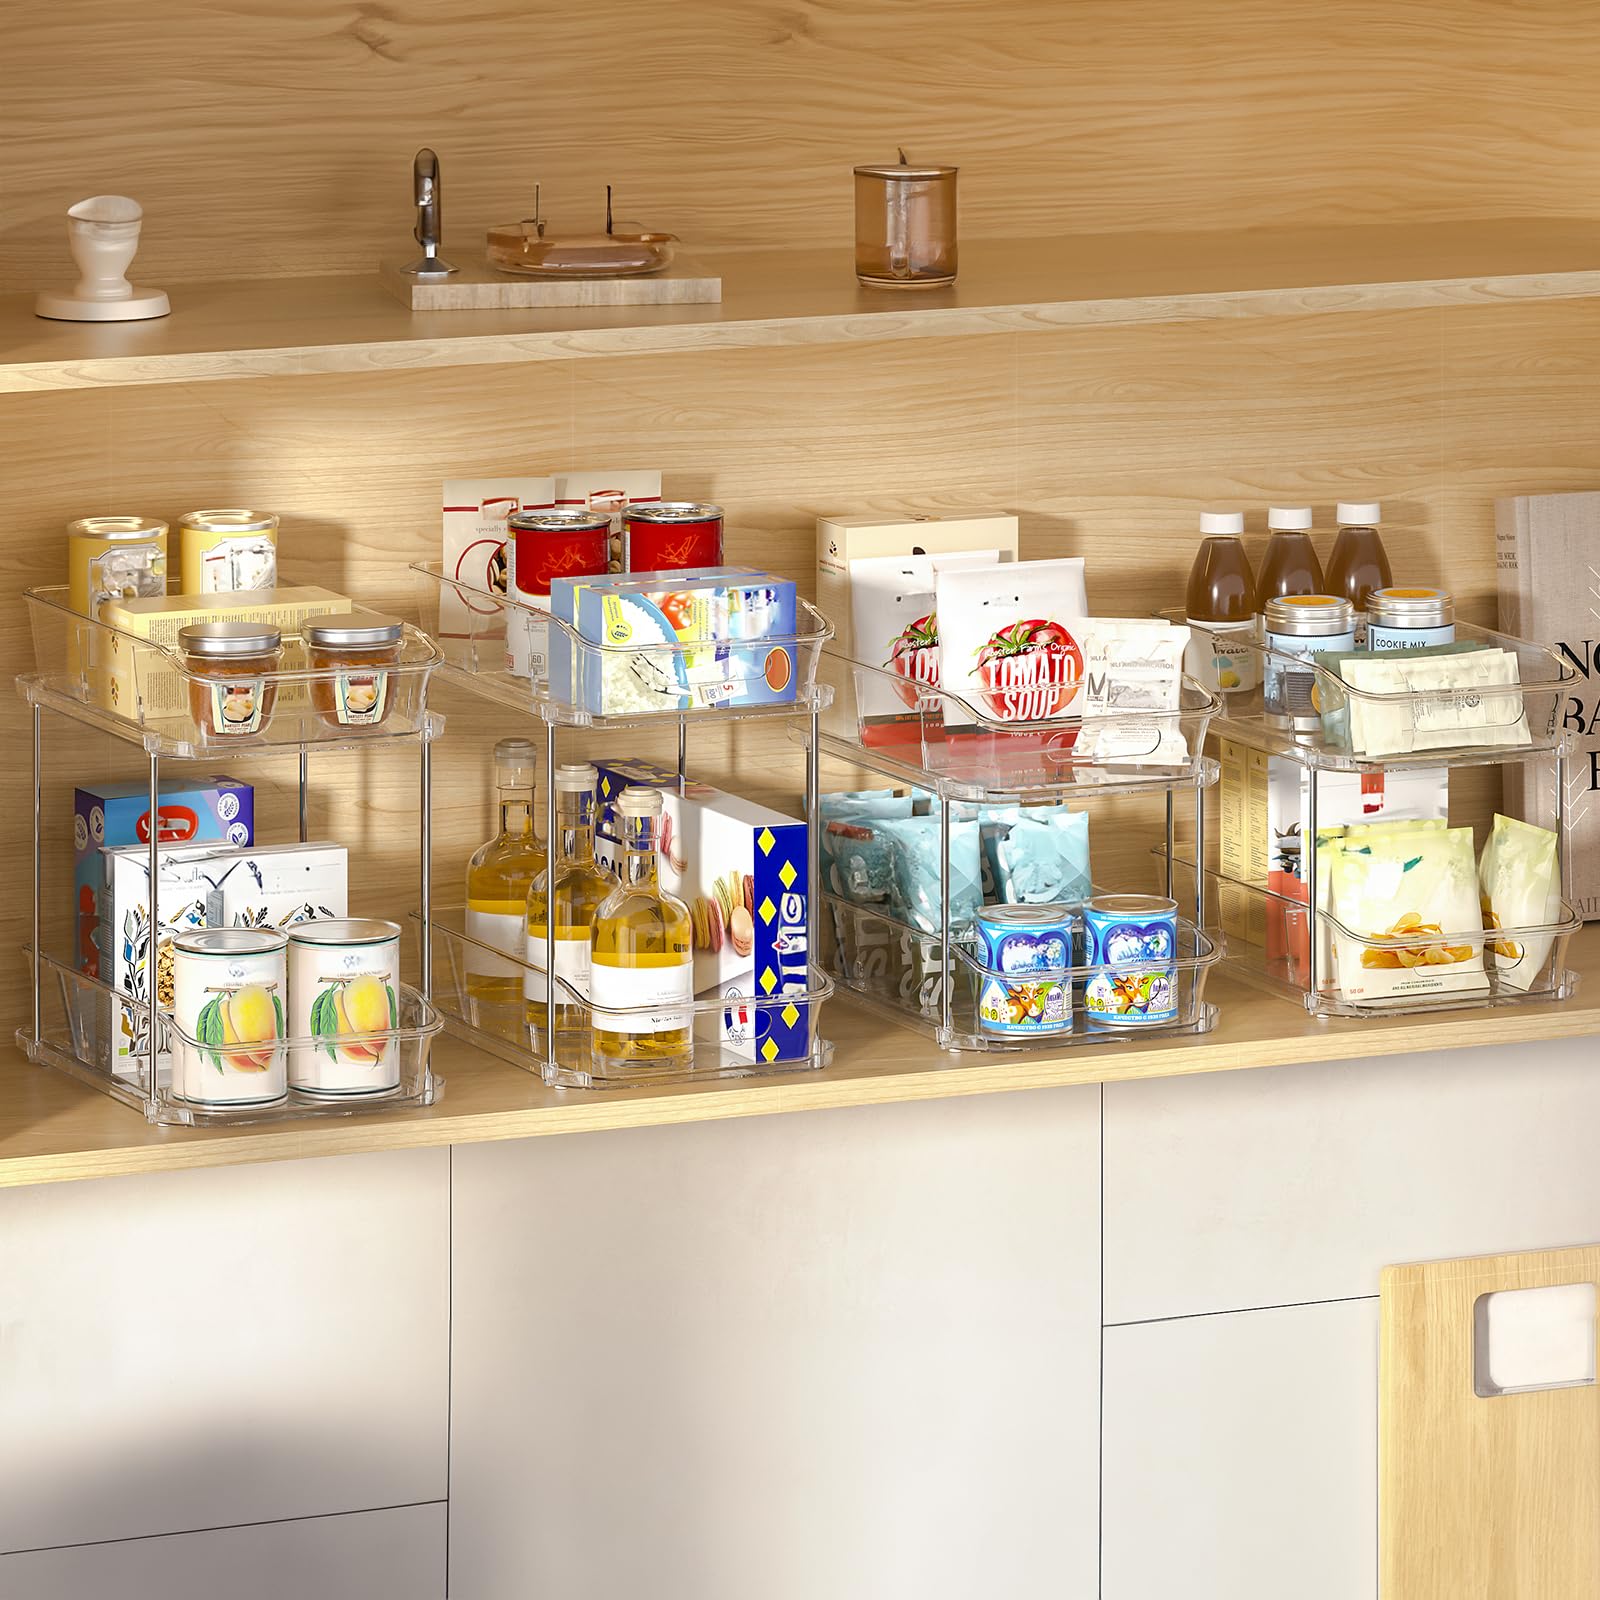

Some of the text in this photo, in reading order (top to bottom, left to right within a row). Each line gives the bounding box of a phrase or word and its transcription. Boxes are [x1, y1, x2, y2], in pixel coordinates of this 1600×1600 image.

[475, 524, 502, 534] specially
[1375, 638, 1427, 649] COOKIE MIX
[532, 654, 542, 664] 60
[985, 653, 1077, 691] TOMATO
[1002, 688, 1061, 721] SOUP
